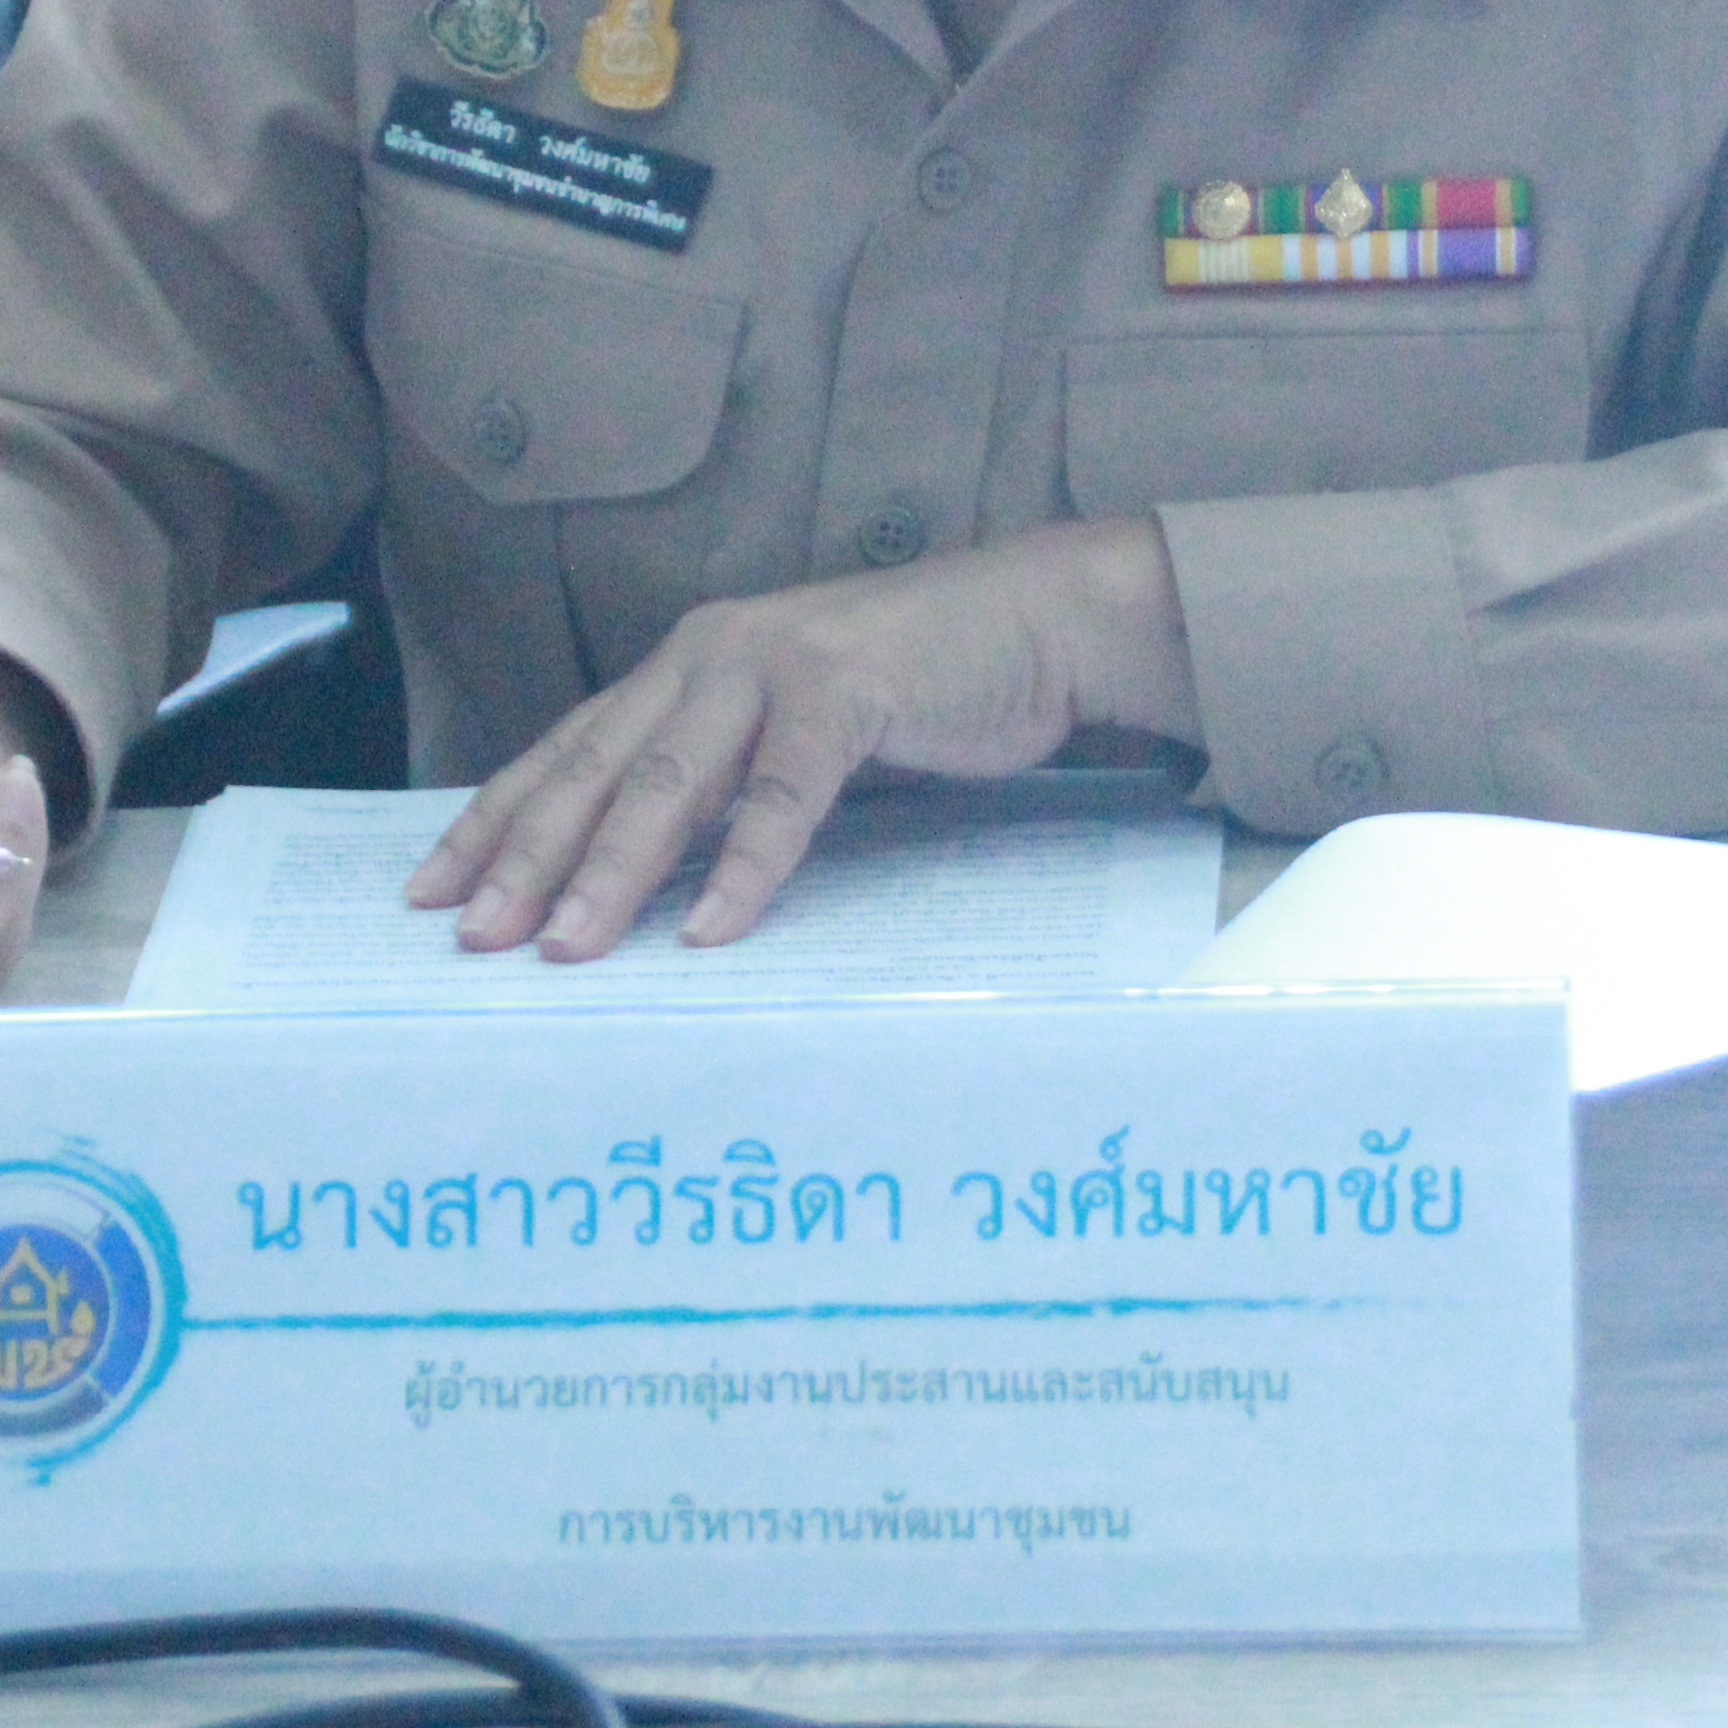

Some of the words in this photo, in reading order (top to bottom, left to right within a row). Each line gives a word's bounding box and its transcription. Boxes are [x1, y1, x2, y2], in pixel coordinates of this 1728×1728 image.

[237, 1134, 901, 1251] นางสาววีรธิดา
[949, 1124, 1464, 1239] วงศ์มหาชัย
[403, 1352, 1290, 1427] ผู้อำนวยการกลุ่มงานประสานและสนับสนุน
[558, 1489, 1133, 1555] การบริหารงานพัฒนาชุมชน
